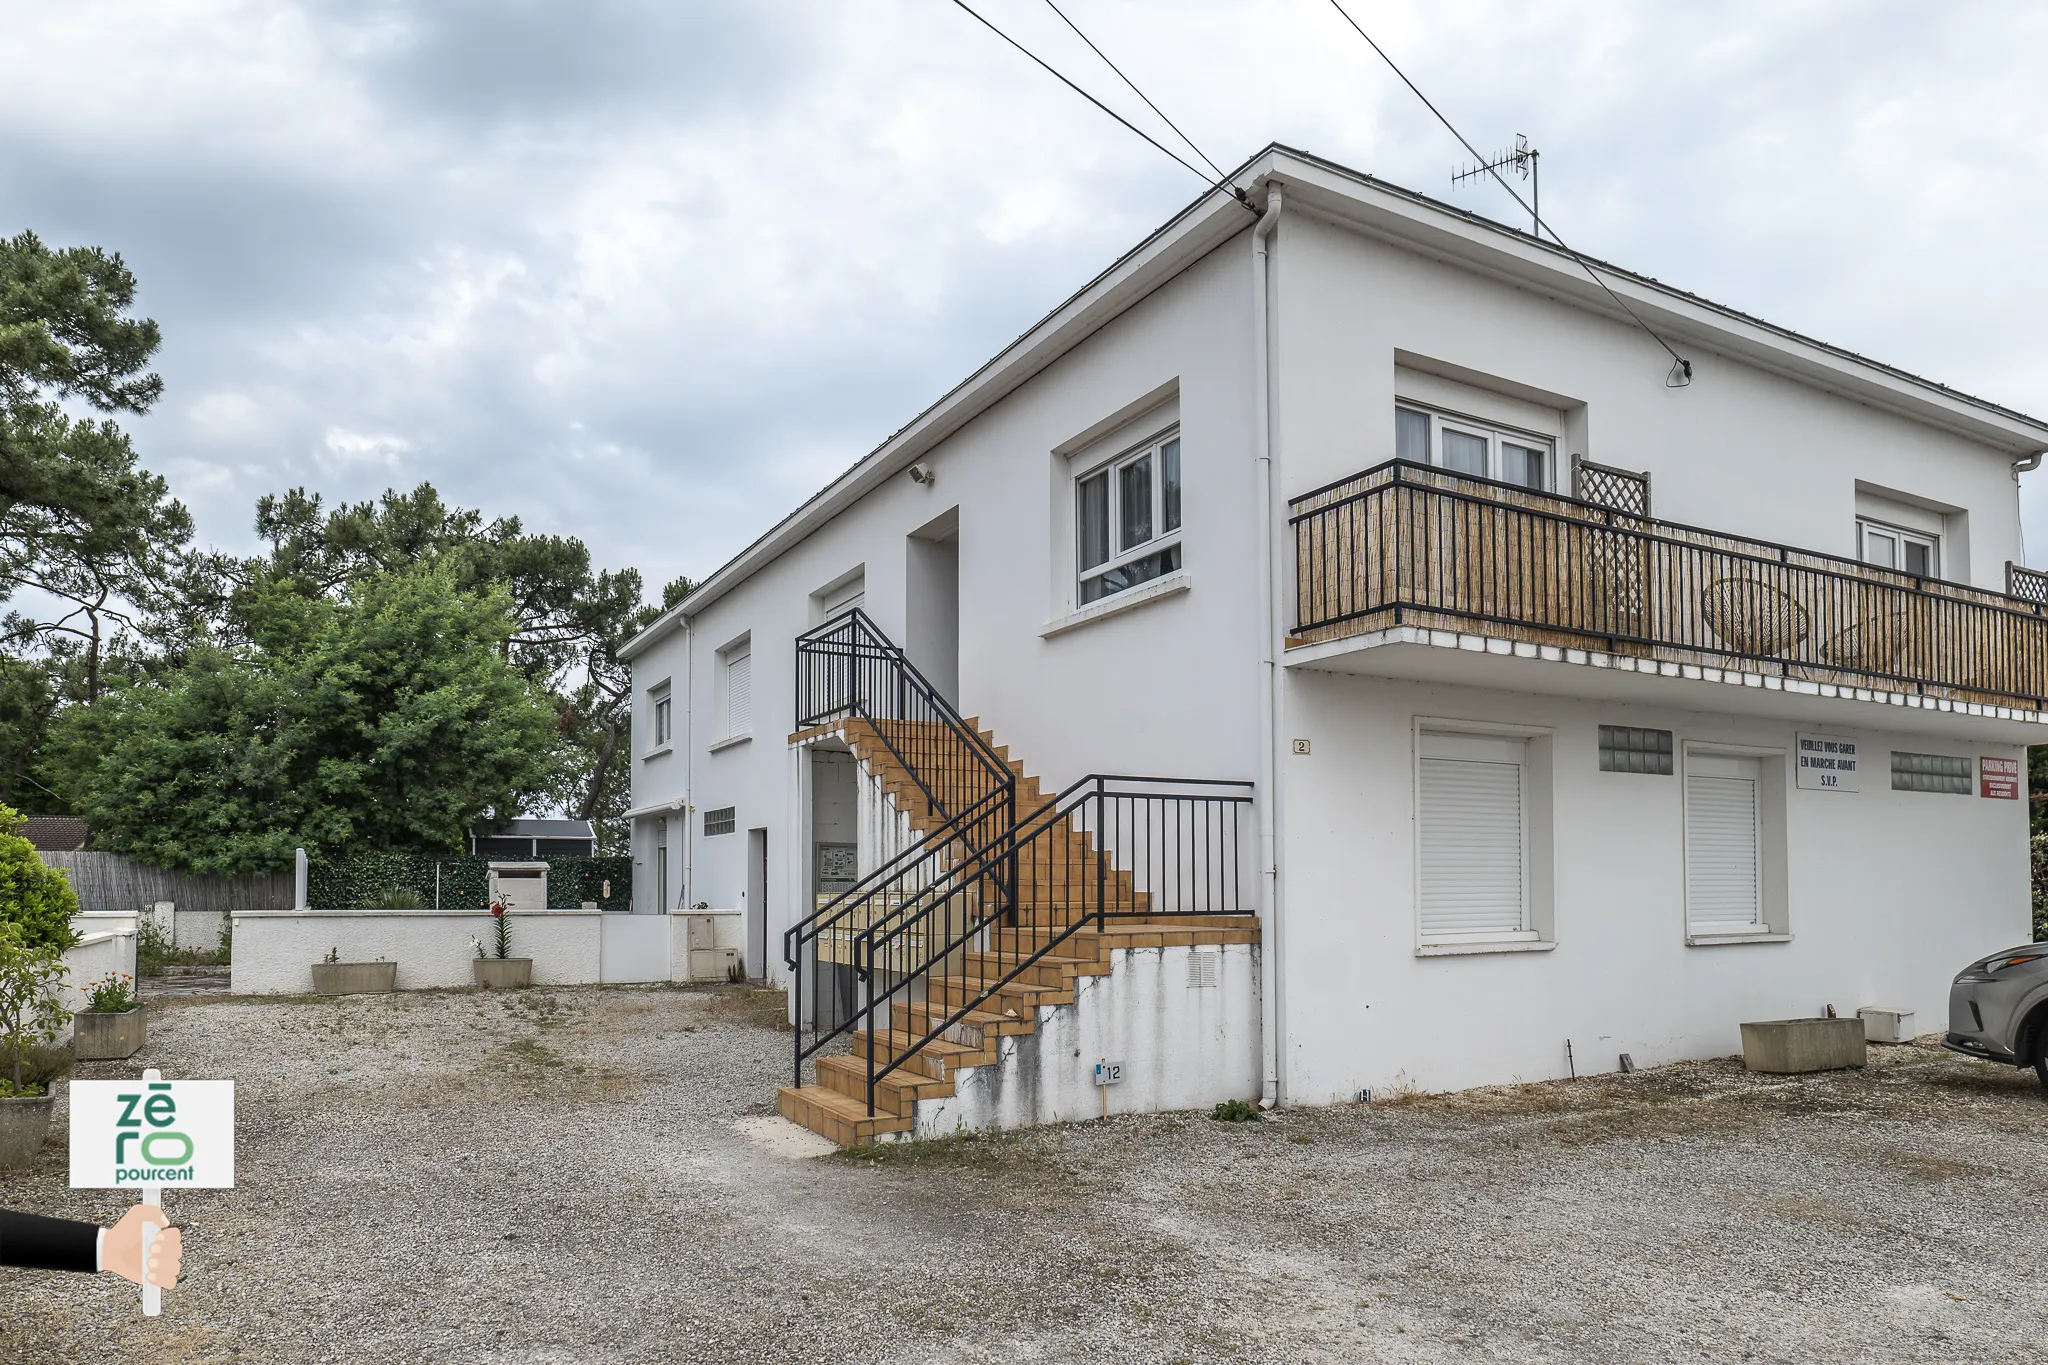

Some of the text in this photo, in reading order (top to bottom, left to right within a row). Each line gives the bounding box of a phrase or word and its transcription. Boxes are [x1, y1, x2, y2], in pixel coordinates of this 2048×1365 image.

[1298, 741, 1305, 751] 2
[1800, 739, 1856, 755] VEUILLEZ VOUS GARER
[1801, 756, 1856, 771] EN MARCHE AVANT
[1982, 759, 2003, 773] PARKING
[1821, 775, 1838, 787] S.V.P.
[1107, 1065, 1120, 1080] 12
